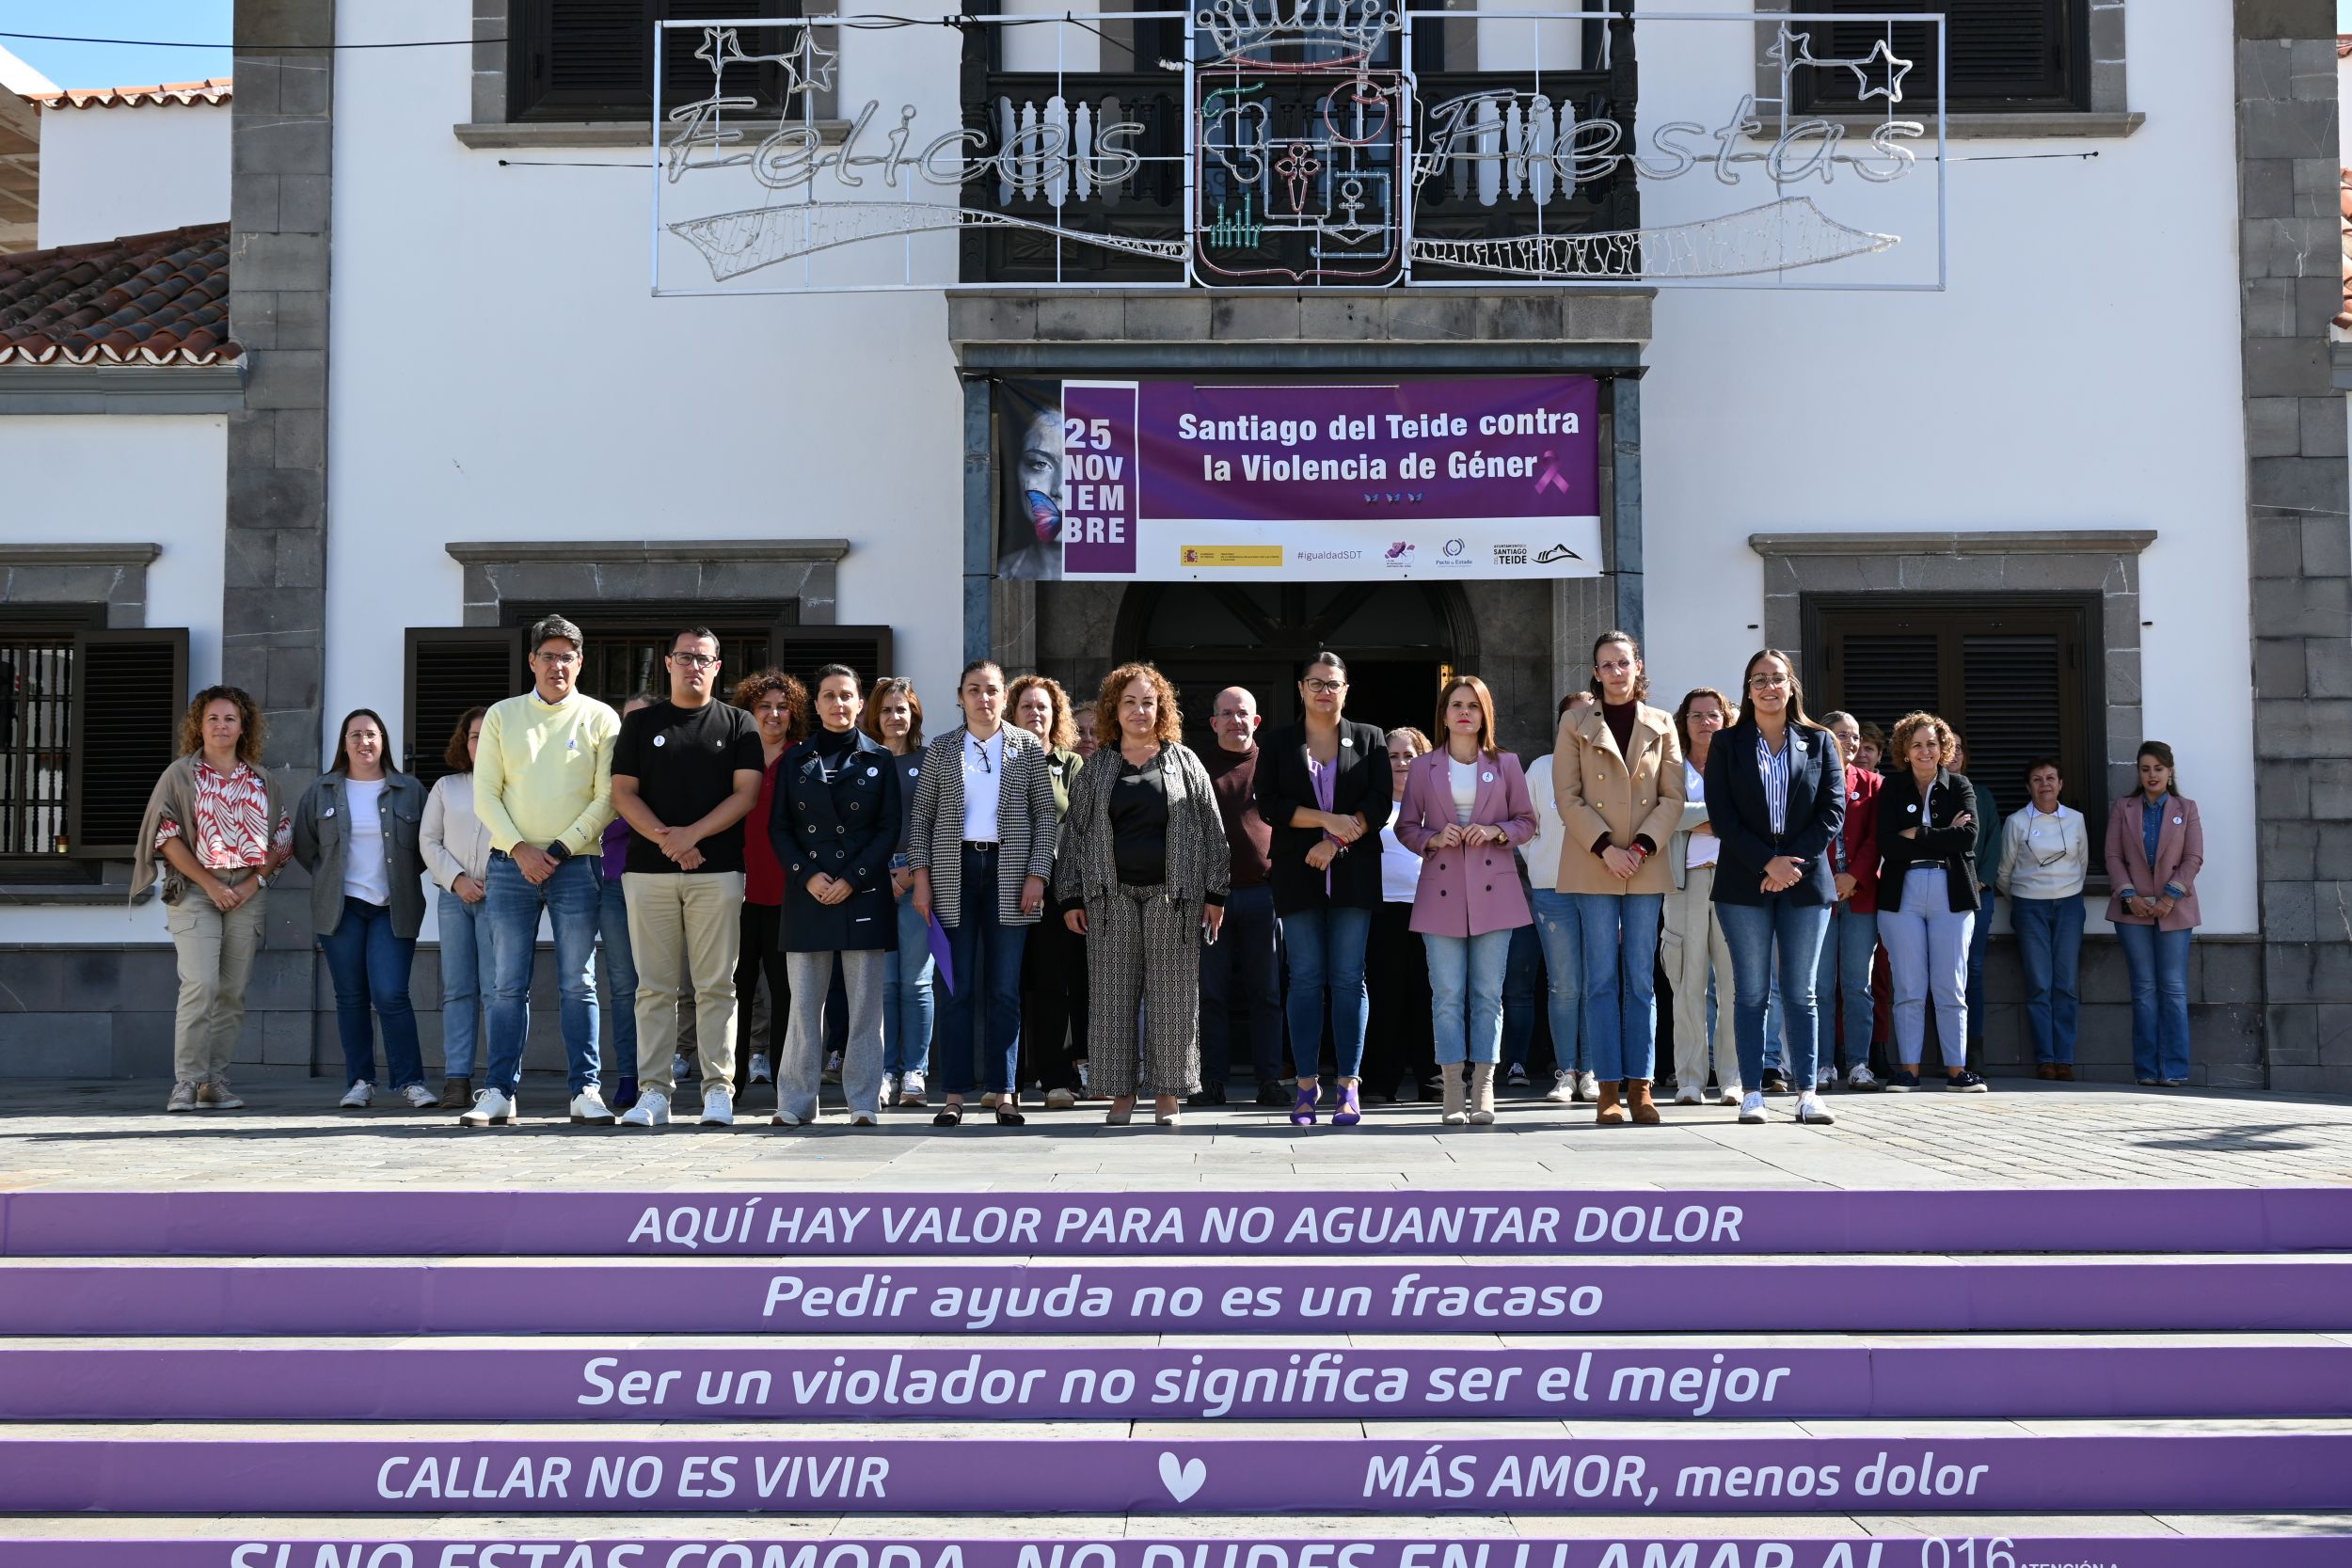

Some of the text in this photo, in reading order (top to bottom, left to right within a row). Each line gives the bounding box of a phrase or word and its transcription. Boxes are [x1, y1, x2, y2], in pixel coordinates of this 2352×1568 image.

[668, 88, 1925, 188] Felices Fiestas
[1065, 418, 1111, 450] 25
[1178, 408, 1579, 446] Santiago del Teide contra
[1064, 454, 1123, 481] NOV
[1203, 455, 1232, 481] la
[1241, 453, 1387, 482] Violencia
[1399, 452, 1436, 479] de
[1064, 484, 1124, 511] IEM
[1064, 516, 1125, 543] BRE
[1297, 550, 1362, 562] #igualdadSDT
[1499, 555, 1527, 564] TEIDE
[627, 1197, 1743, 1248] AQUÍ HAY VALOR PARA NO AGUANTAR DOLOR
[762, 1273, 1603, 1329] Pedir ayuda no es un fracaso
[577, 1352, 1791, 1418] Ser un violador no significa ser el mejor
[376, 1455, 890, 1498] CALLAR NO ES VIVIR
[1362, 1444, 1989, 1507] MÁS AMOR, menos dolor
